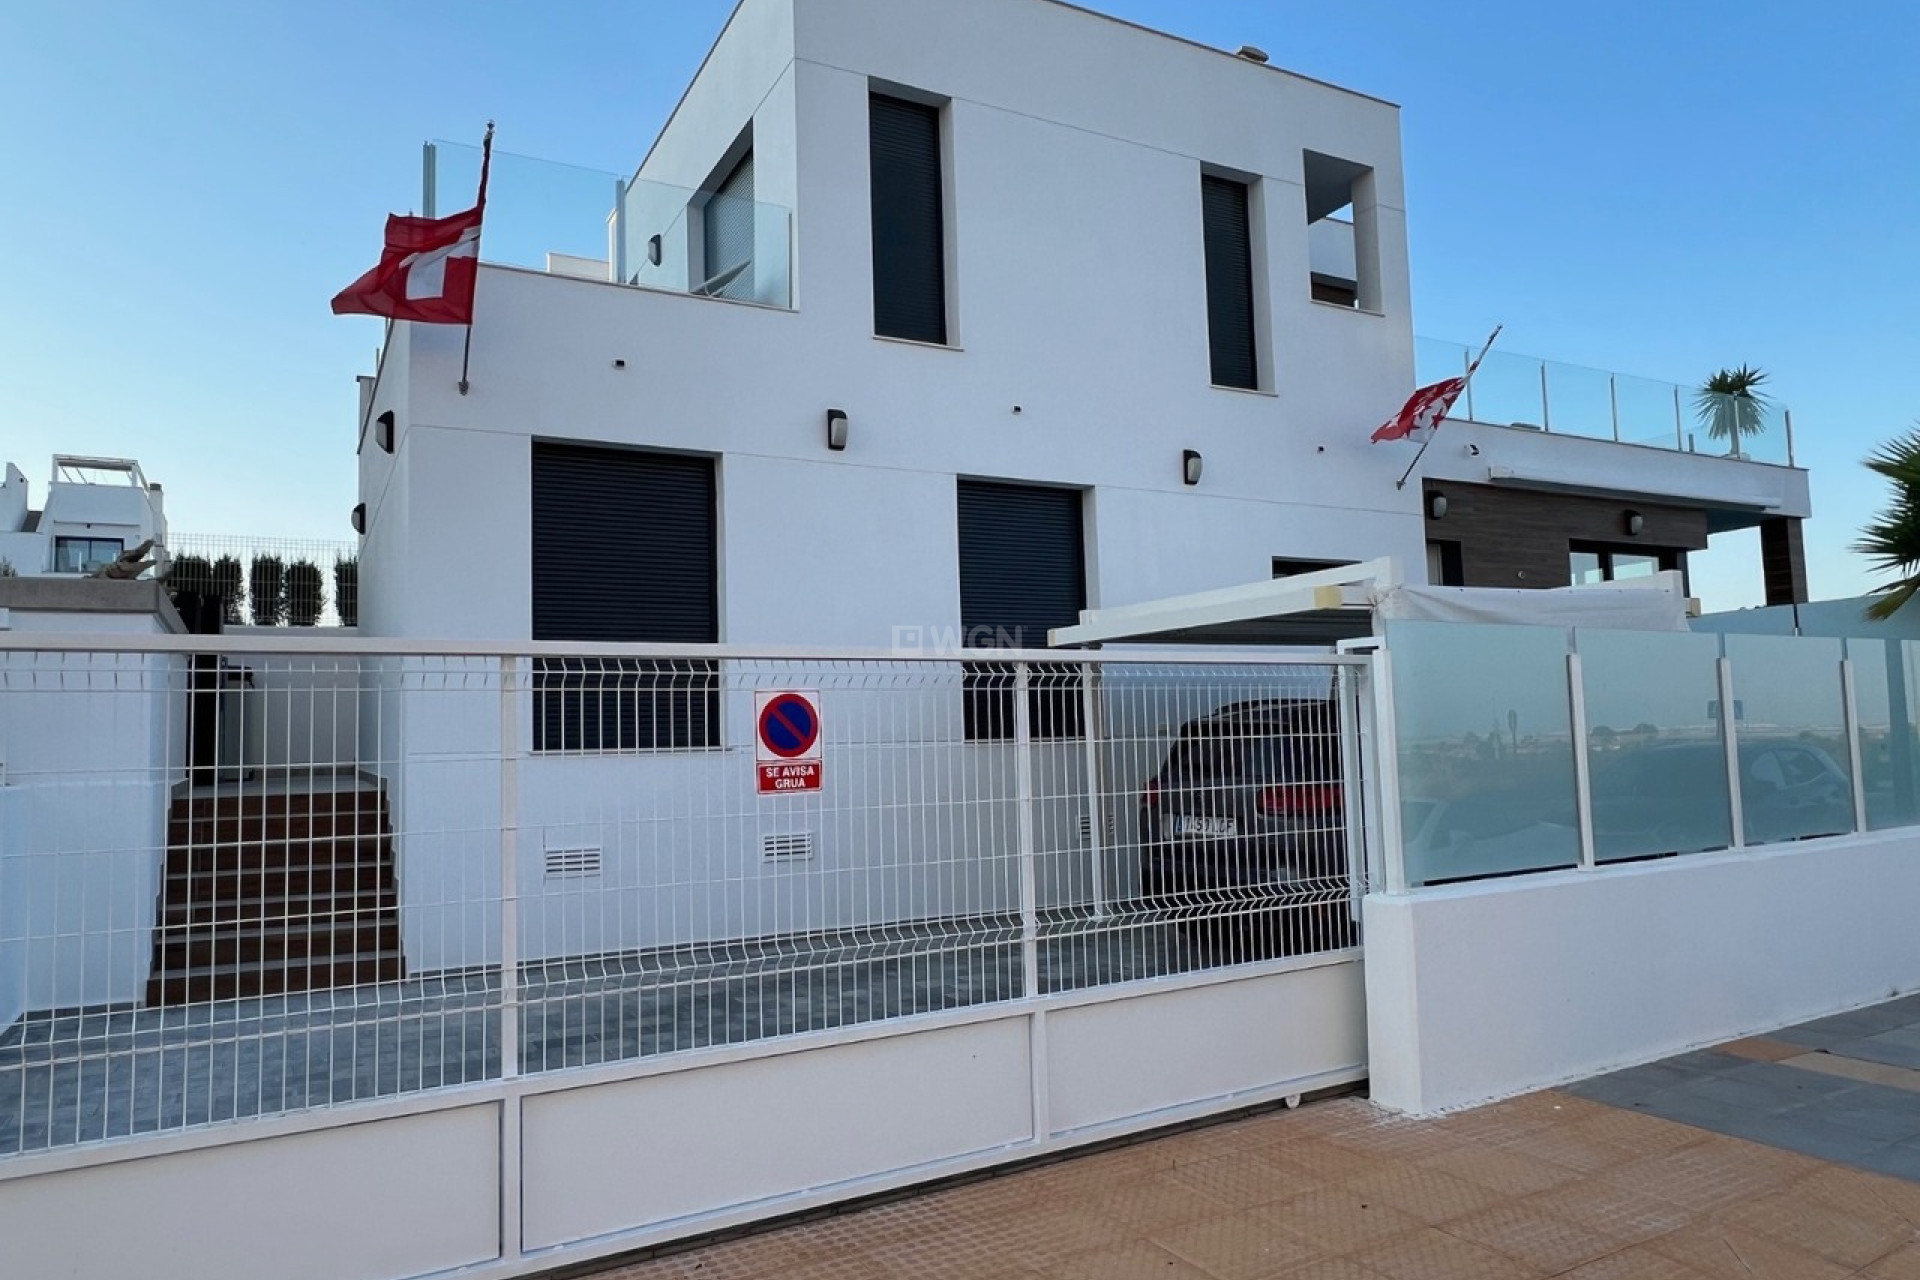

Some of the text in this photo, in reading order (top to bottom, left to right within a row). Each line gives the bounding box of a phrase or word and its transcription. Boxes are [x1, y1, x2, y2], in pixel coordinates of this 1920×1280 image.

[765, 765, 815, 778] SE AVISA
[775, 778, 806, 789] GRUA
